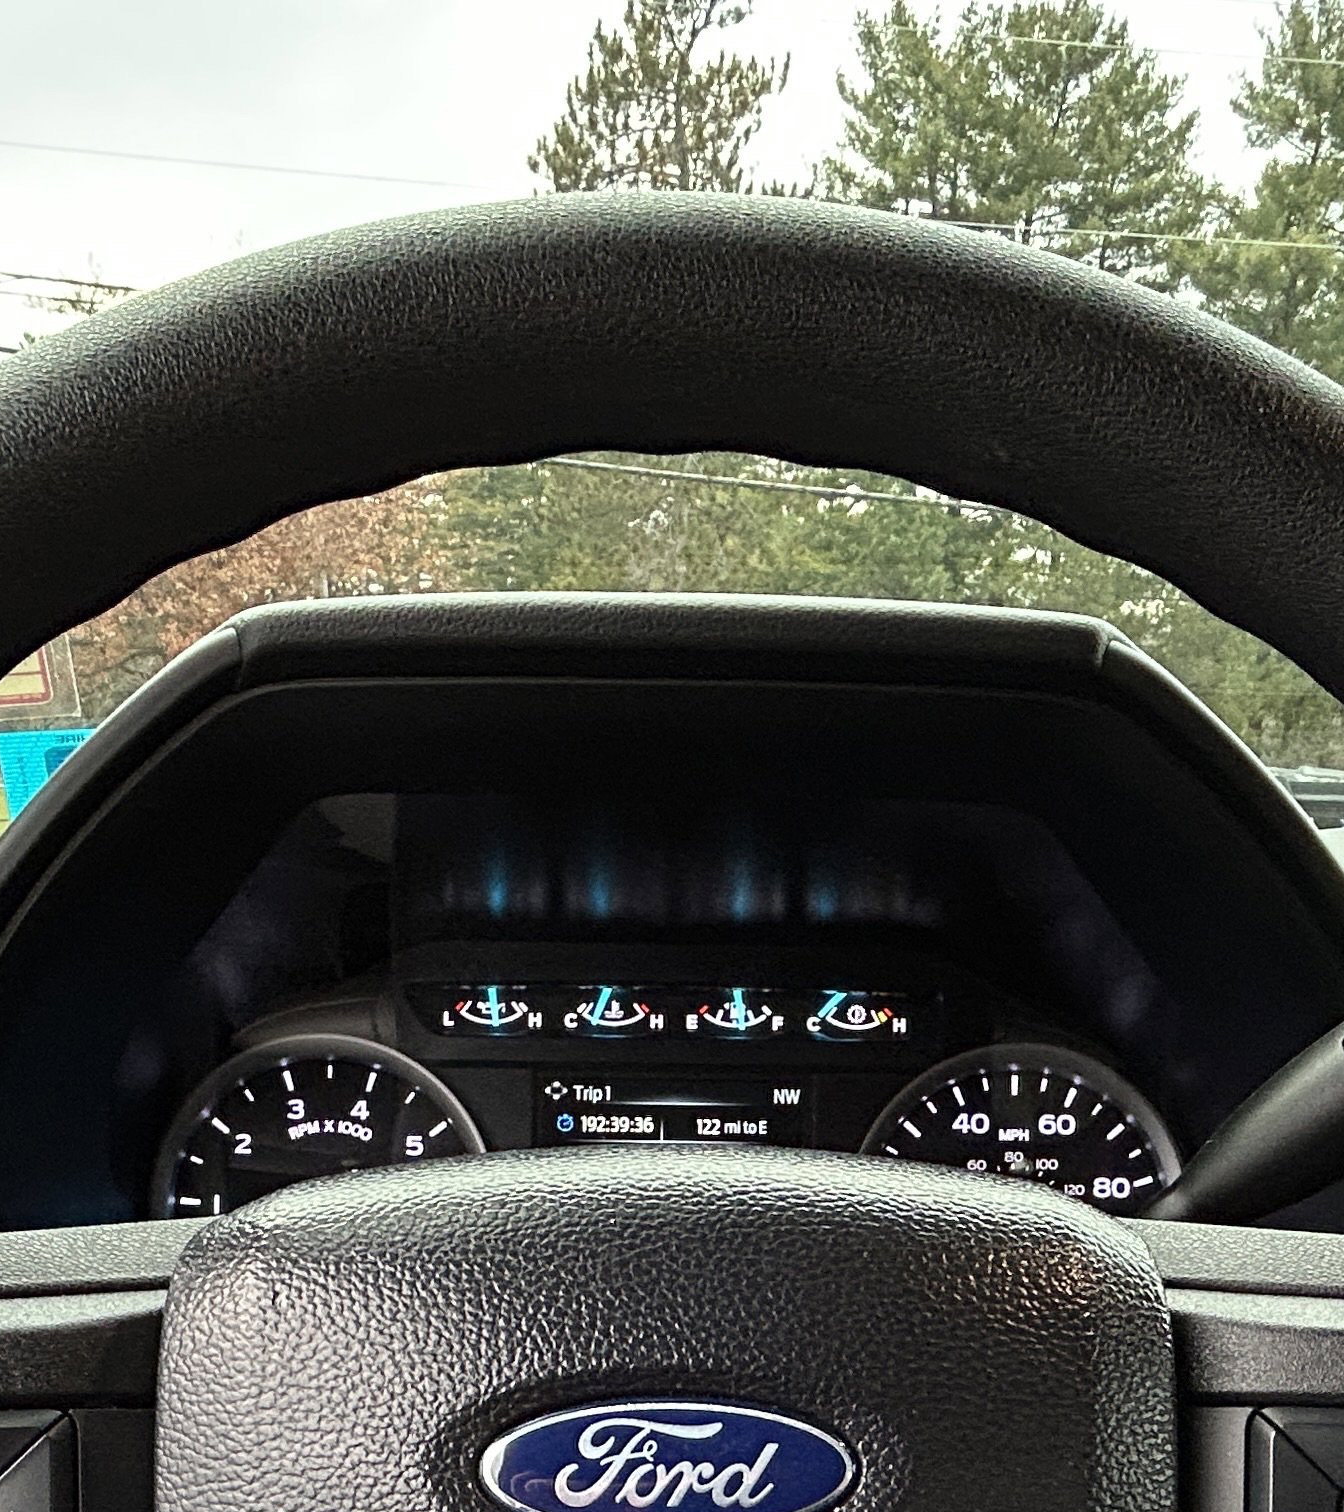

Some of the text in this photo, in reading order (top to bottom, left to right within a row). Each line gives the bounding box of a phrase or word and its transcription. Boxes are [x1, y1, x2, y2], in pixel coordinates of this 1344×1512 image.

[443, 1011, 454, 1027] L
[528, 1012, 542, 1028] H
[564, 1013, 578, 1028] C
[650, 1014, 664, 1029] H
[686, 1014, 698, 1030] E
[772, 1016, 784, 1031] F
[806, 1016, 822, 1032] C
[892, 1017, 907, 1033] H
[773, 1088, 801, 1105] NW
[287, 1099, 305, 1120] 3
[350, 1100, 370, 1120] 4
[288, 1120, 320, 1140] RPM
[337, 1120, 373, 1142] 1000
[580, 1115, 655, 1133] 192:39:36
[696, 1119, 720, 1136] 122
[951, 1113, 991, 1135] 40
[1037, 1114, 1076, 1135] 60
[998, 1128, 1030, 1142] MPH
[234, 1133, 252, 1155] 2
[405, 1135, 424, 1156] 5
[1004, 1151, 1024, 1162] 80
[1035, 1158, 1059, 1170] 100
[967, 1159, 987, 1171] 60
[1063, 1184, 1085, 1196] 120
[1092, 1177, 1131, 1199] 80
[554, 1417, 780, 1508] Ford
